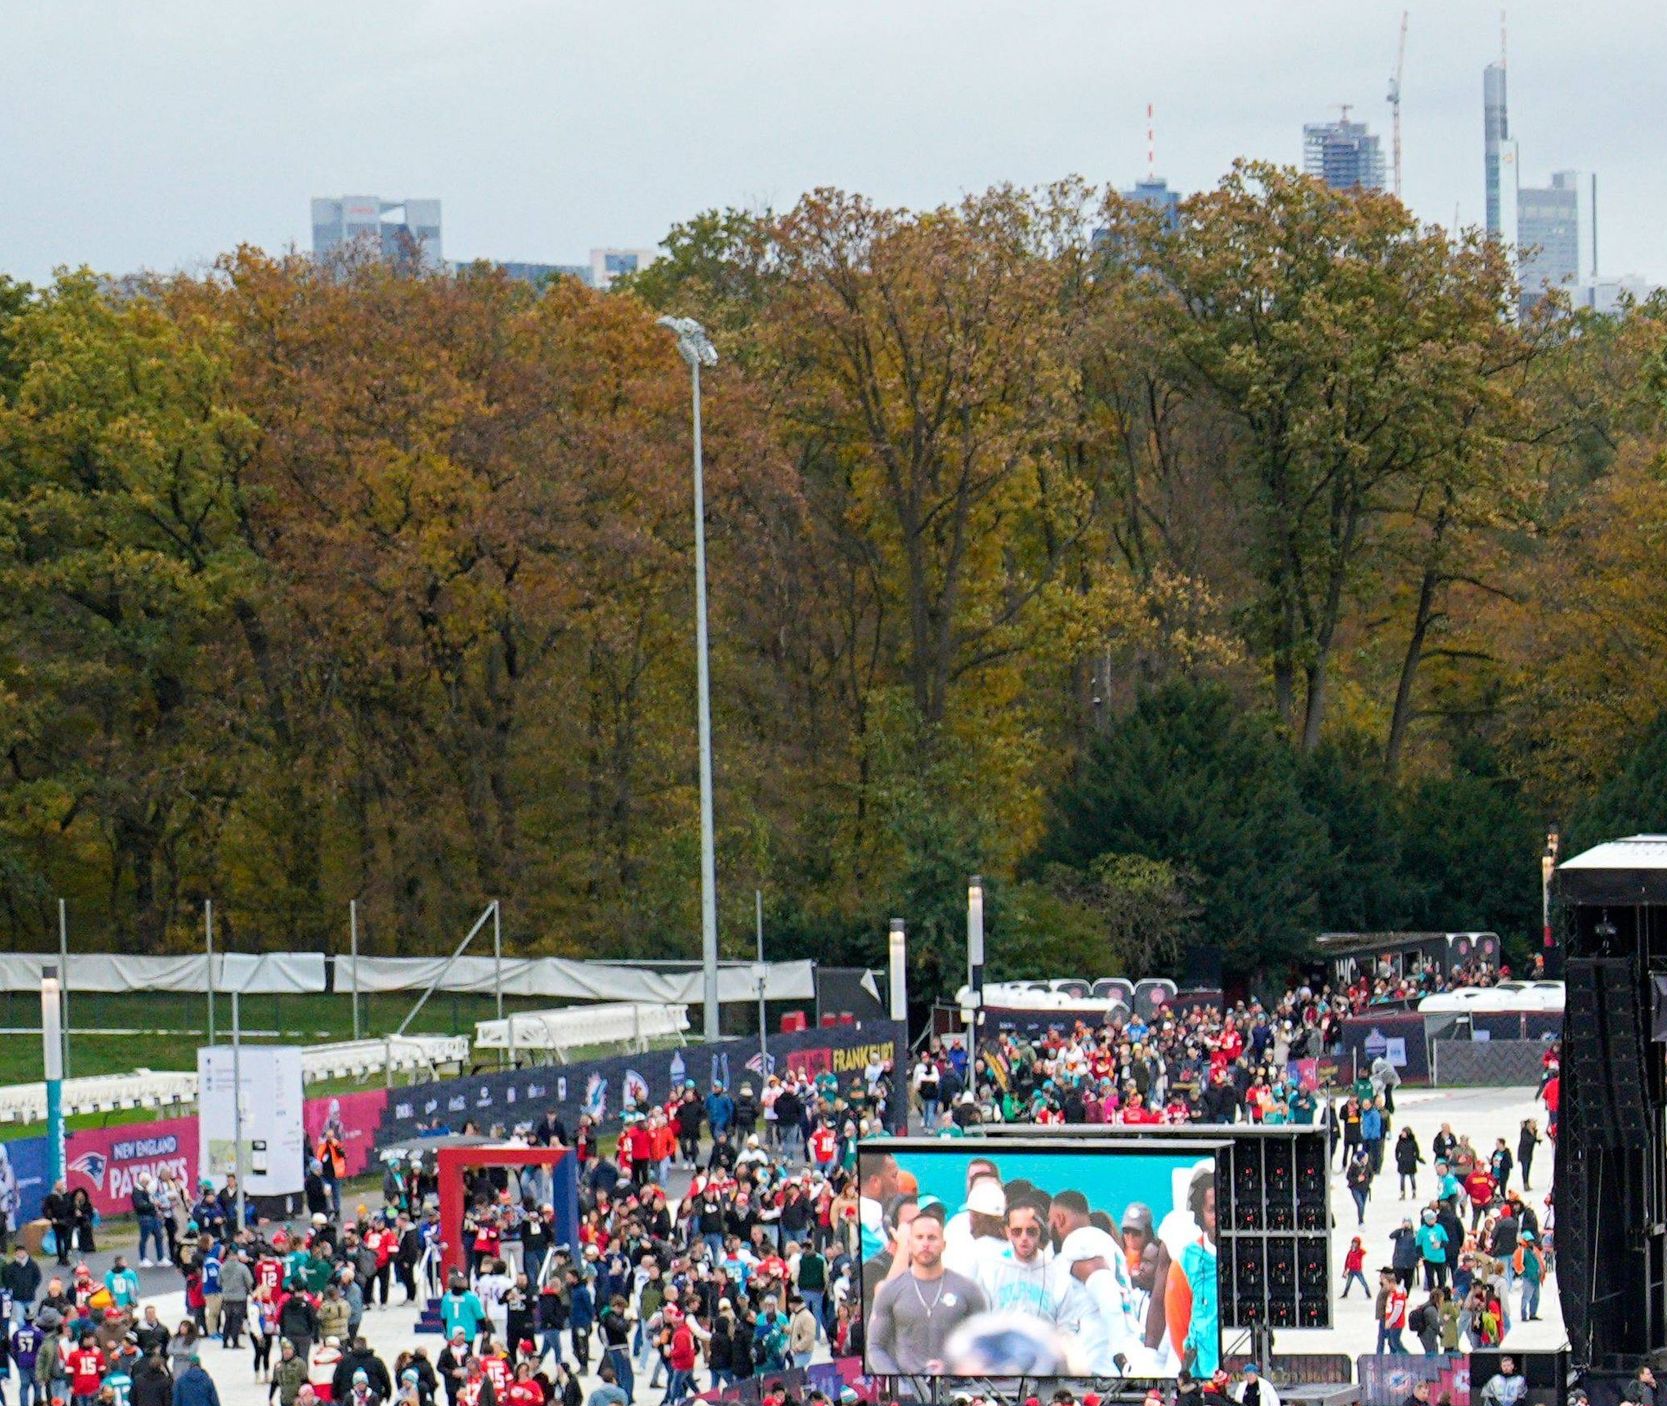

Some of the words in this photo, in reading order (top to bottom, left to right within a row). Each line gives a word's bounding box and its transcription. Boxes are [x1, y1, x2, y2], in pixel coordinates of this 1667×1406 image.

[112, 1141, 135, 1160] NEW
[136, 1135, 177, 1156] ENGLAND
[80, 1356, 96, 1374] 15
